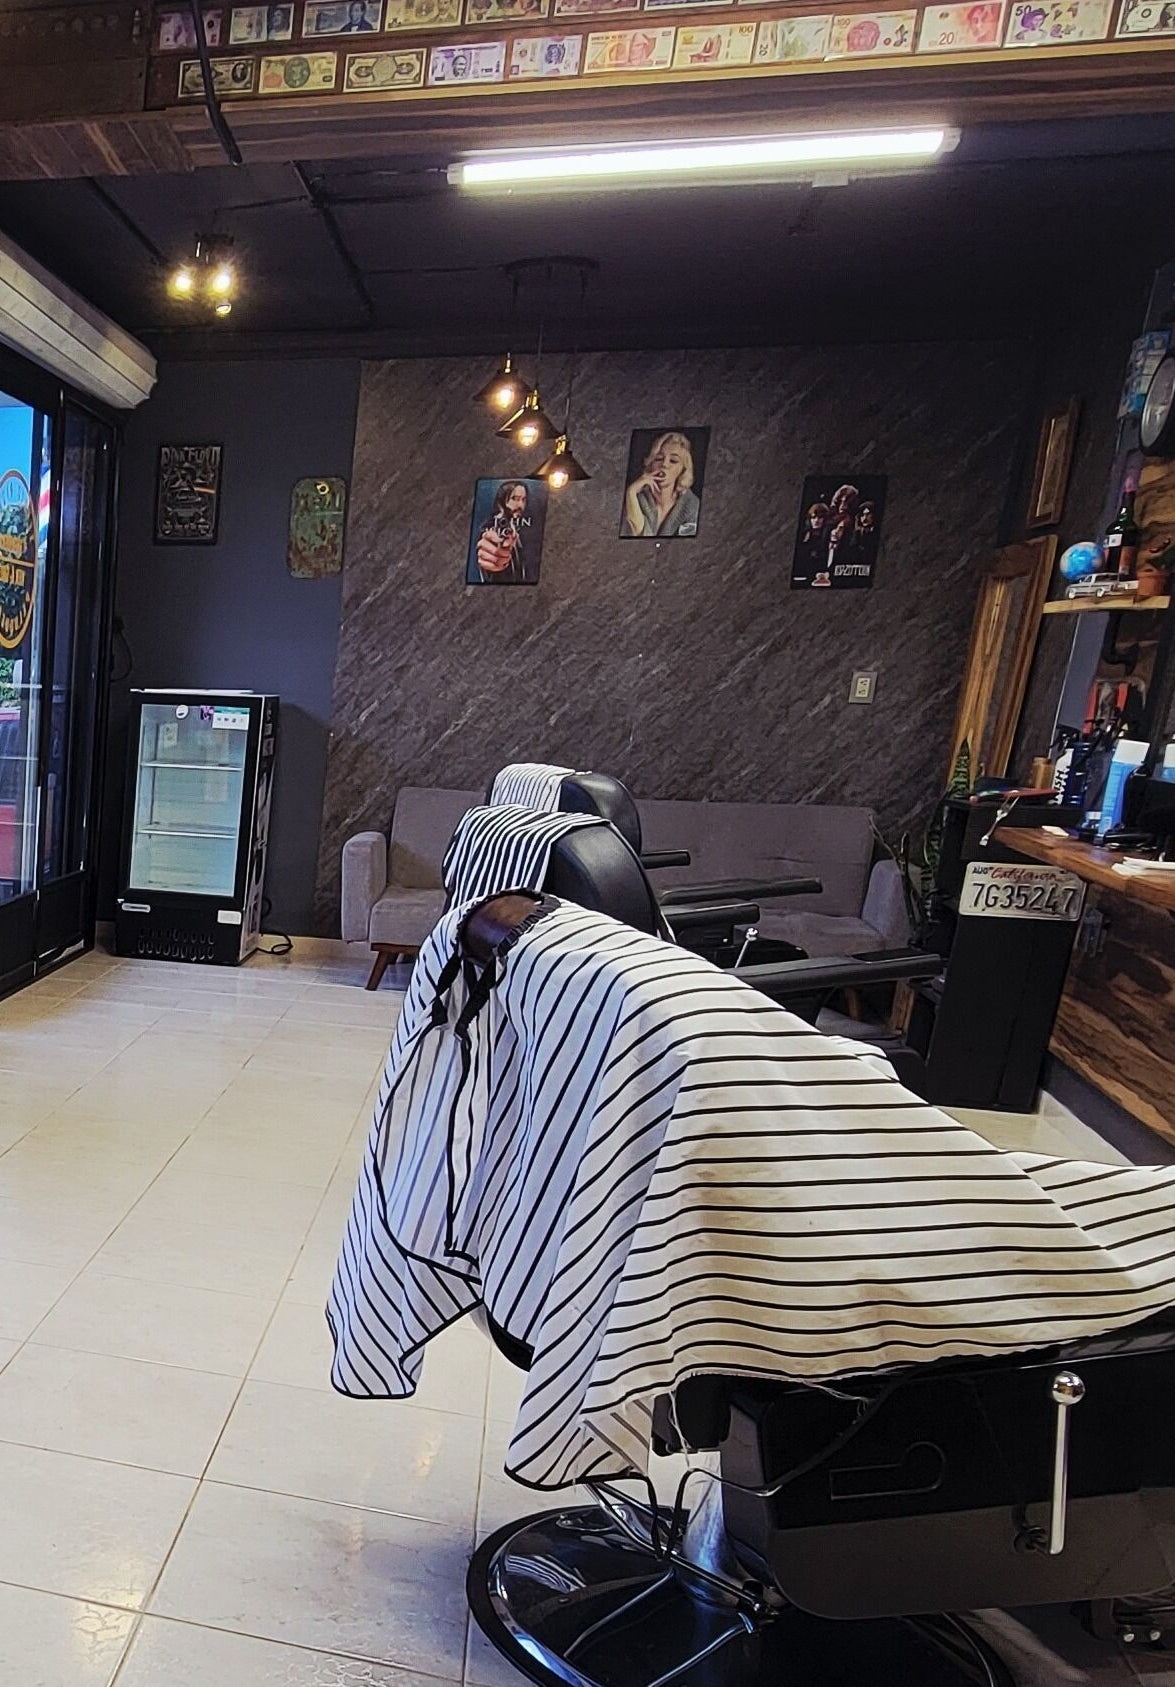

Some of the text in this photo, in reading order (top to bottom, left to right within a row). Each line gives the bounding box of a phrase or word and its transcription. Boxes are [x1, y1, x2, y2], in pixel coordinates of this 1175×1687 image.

[738, 25, 754, 34] 100
[938, 32, 955, 46] 20
[972, 882, 1078, 914] 7G35247
